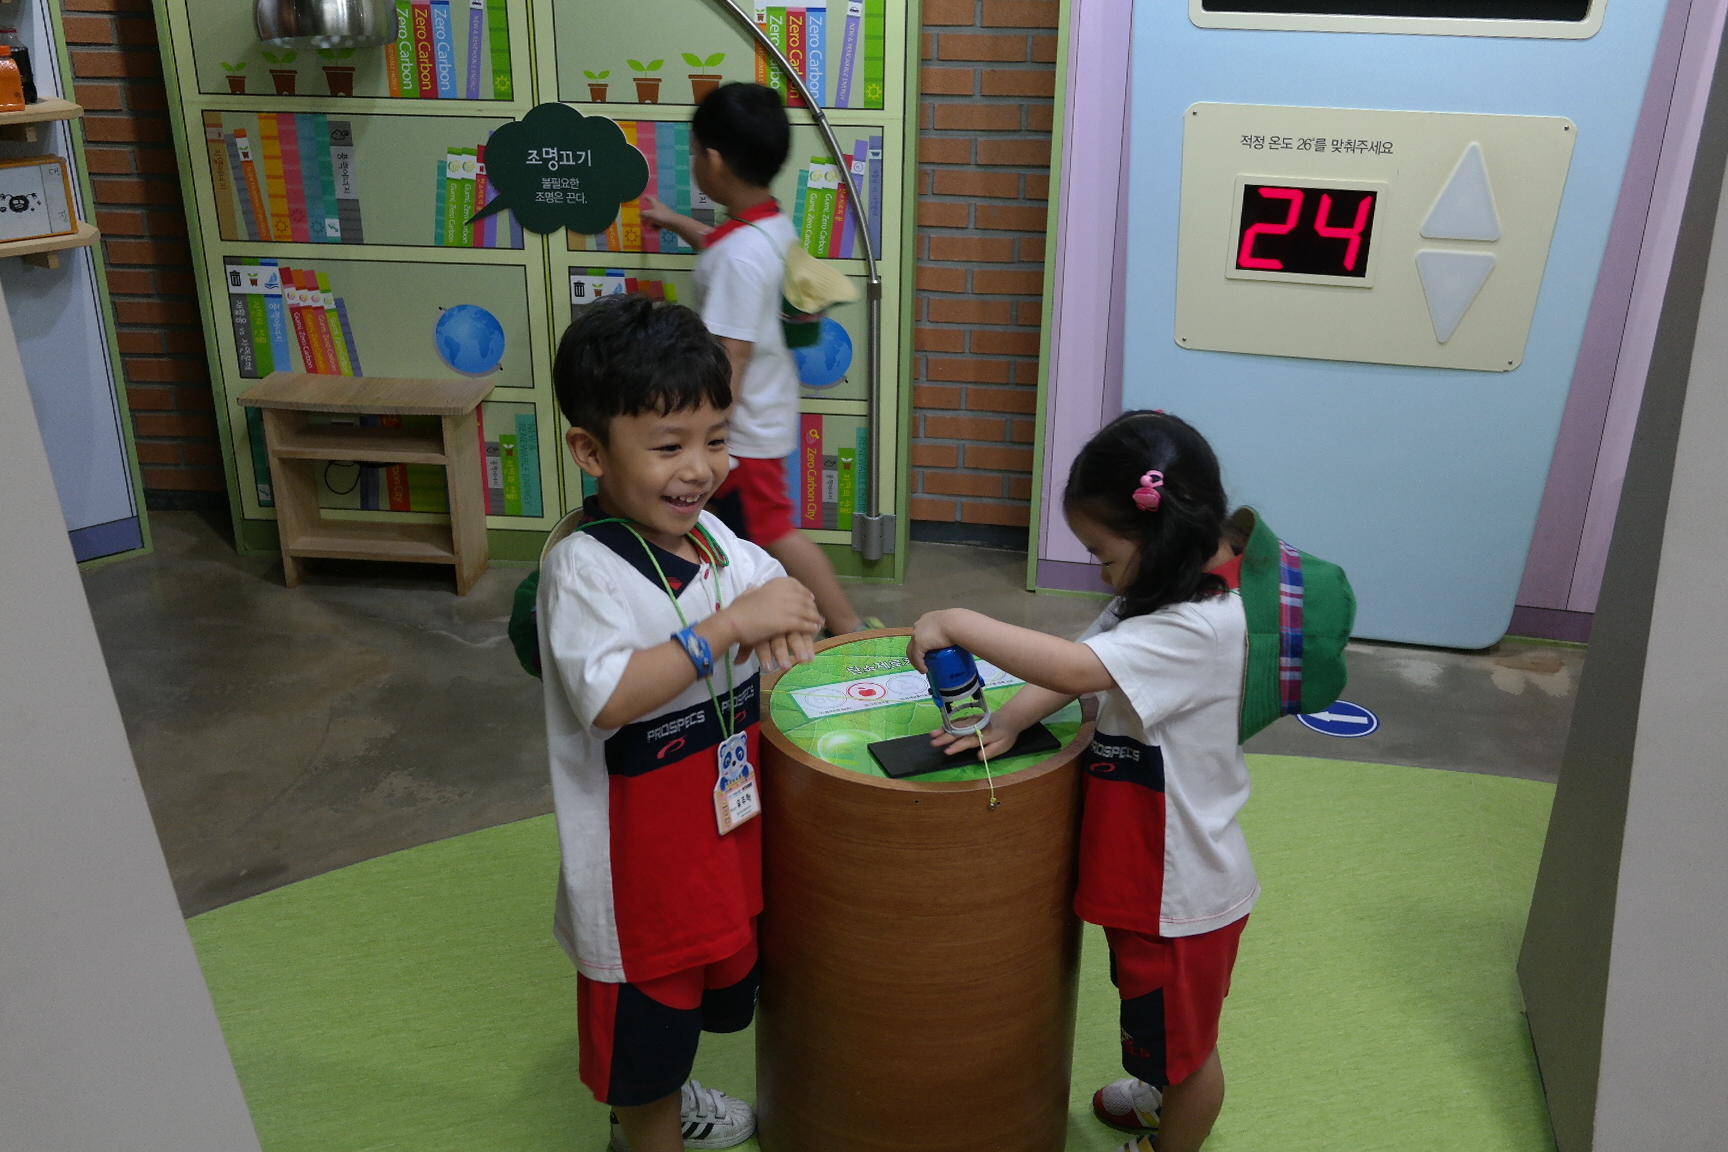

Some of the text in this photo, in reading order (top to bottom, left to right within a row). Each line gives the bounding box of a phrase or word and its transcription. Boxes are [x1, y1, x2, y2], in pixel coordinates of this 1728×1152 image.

[770, 16, 783, 46] Zero
[790, 16, 803, 48] Zero
[848, 23, 856, 36] NEW
[397, 8, 414, 90] Zero Carbon
[414, 8, 433, 90] Zero Carbon
[434, 8, 452, 90] Zero Carbon
[810, 16, 823, 99] Zero Carbon
[844, 43, 853, 77] RENEWABLE
[840, 78, 849, 101] ENERGY
[525, 146, 592, 172] 조명끄기
[1240, 134, 1266, 150] 적정
[1268, 136, 1294, 150] 온도
[1331, 139, 1394, 156] 맞춰주세요
[336, 152, 351, 194] 풍력에너지
[541, 177, 580, 190] 불필요한
[464, 184, 472, 203] Gumi,
[535, 192, 588, 204] 조명은 끈다.
[808, 192, 818, 212] Gumi,
[463, 204, 471, 220] Zero
[806, 214, 815, 228] Zero
[818, 193, 832, 254] Gumi, Zero Carbon
[448, 220, 456, 243] Carbon
[1238, 187, 1372, 272] 24
[236, 300, 246, 324] 재활용
[268, 302, 282, 342] 풍력에너지
[239, 327, 245, 336] vs
[299, 331, 307, 344] Zero
[303, 346, 314, 368] Carbon
[315, 348, 326, 370] Carbon
[323, 334, 331, 347] Zero
[327, 349, 337, 370] Carbon
[339, 351, 349, 373] Carbon
[520, 424, 532, 506] RENEWABLE ENERGY
[858, 436, 868, 486] RENEWABLE
[393, 485, 404, 502] City
[504, 460, 518, 501] 자연의 선물
[804, 447, 818, 520] Zero Carbon City
[840, 474, 852, 514] 자연의 선물
[646, 710, 706, 744] PROSPECS
[1090, 740, 1140, 762] ROSPECS
